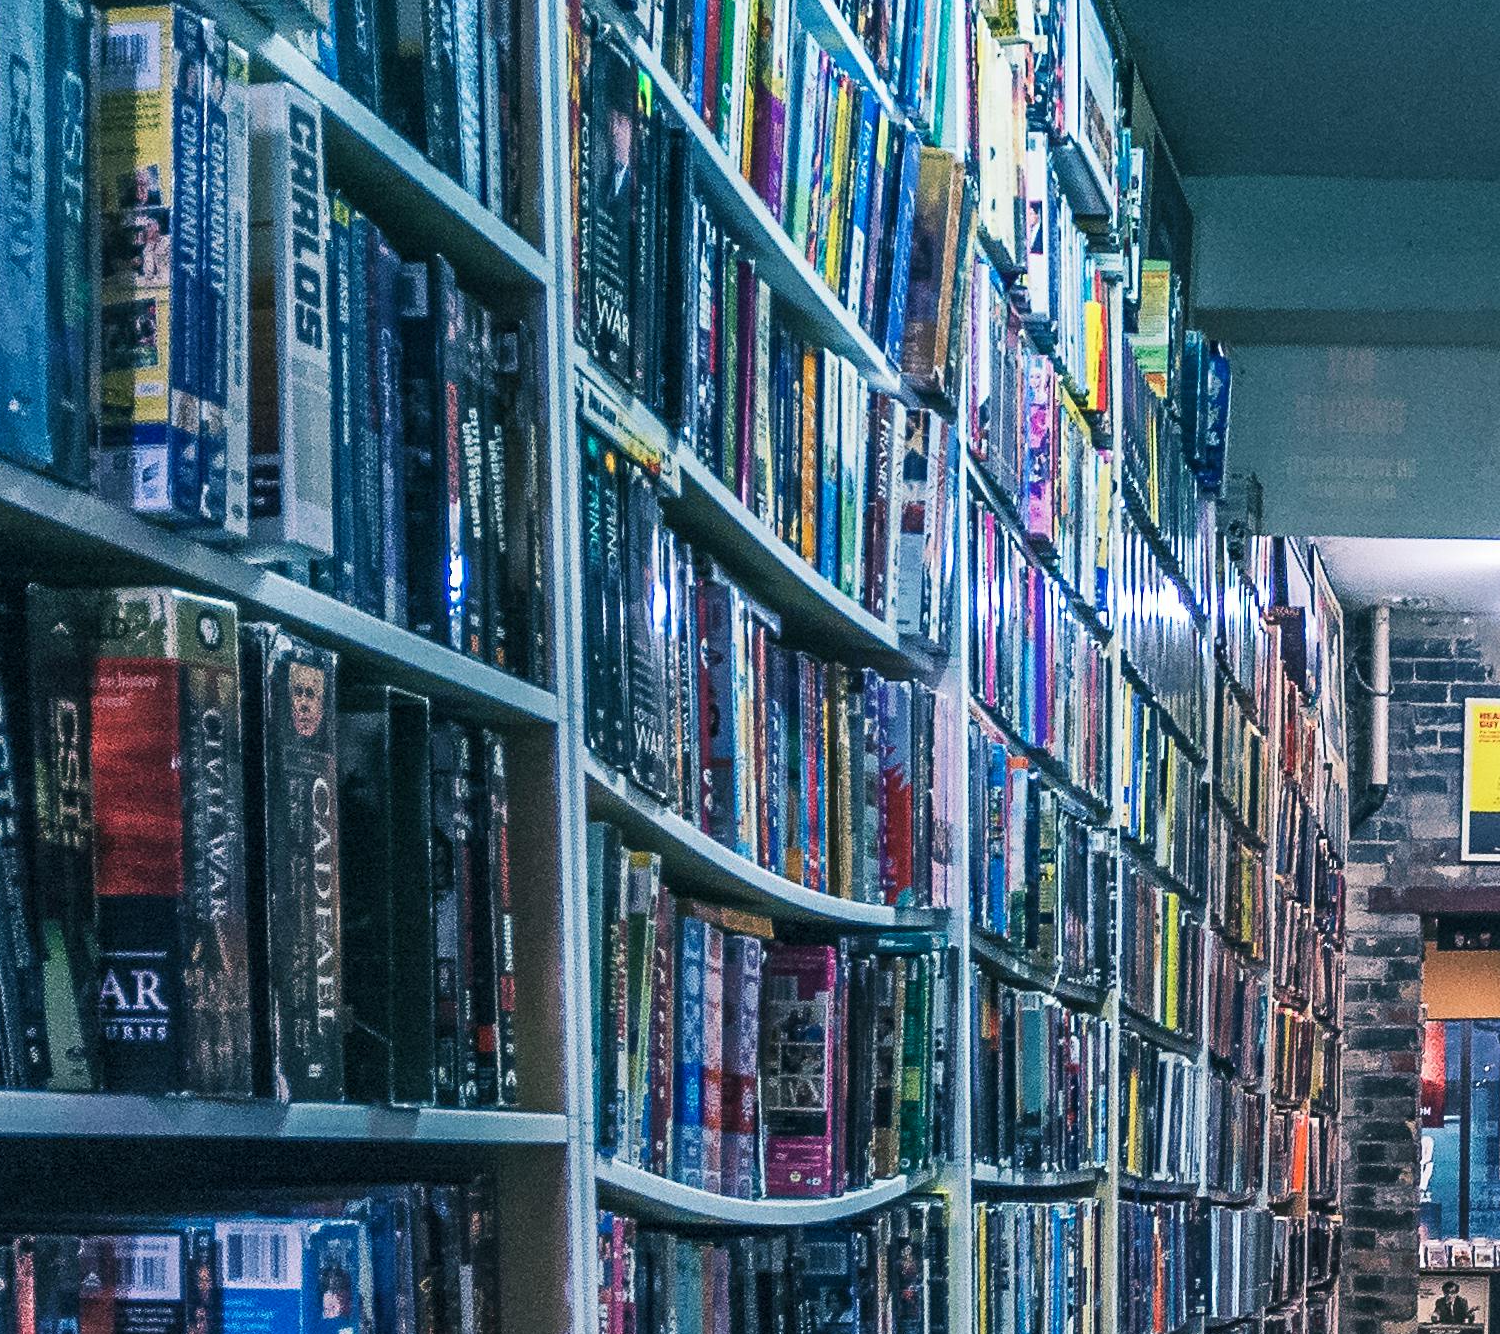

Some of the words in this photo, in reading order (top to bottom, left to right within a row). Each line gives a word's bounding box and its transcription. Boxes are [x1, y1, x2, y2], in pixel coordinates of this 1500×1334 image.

[179, 103, 199, 277] COMMUNITY
[211, 121, 228, 295] COMMUNITY
[288, 111, 322, 348] CARLOS
[203, 709, 224, 821] CIVIL
[1478, 720, 1495, 728] GUT
[206, 831, 231, 923] WAR
[312, 777, 337, 1033] CADFAEL
[102, 1023, 169, 1042] URNS
